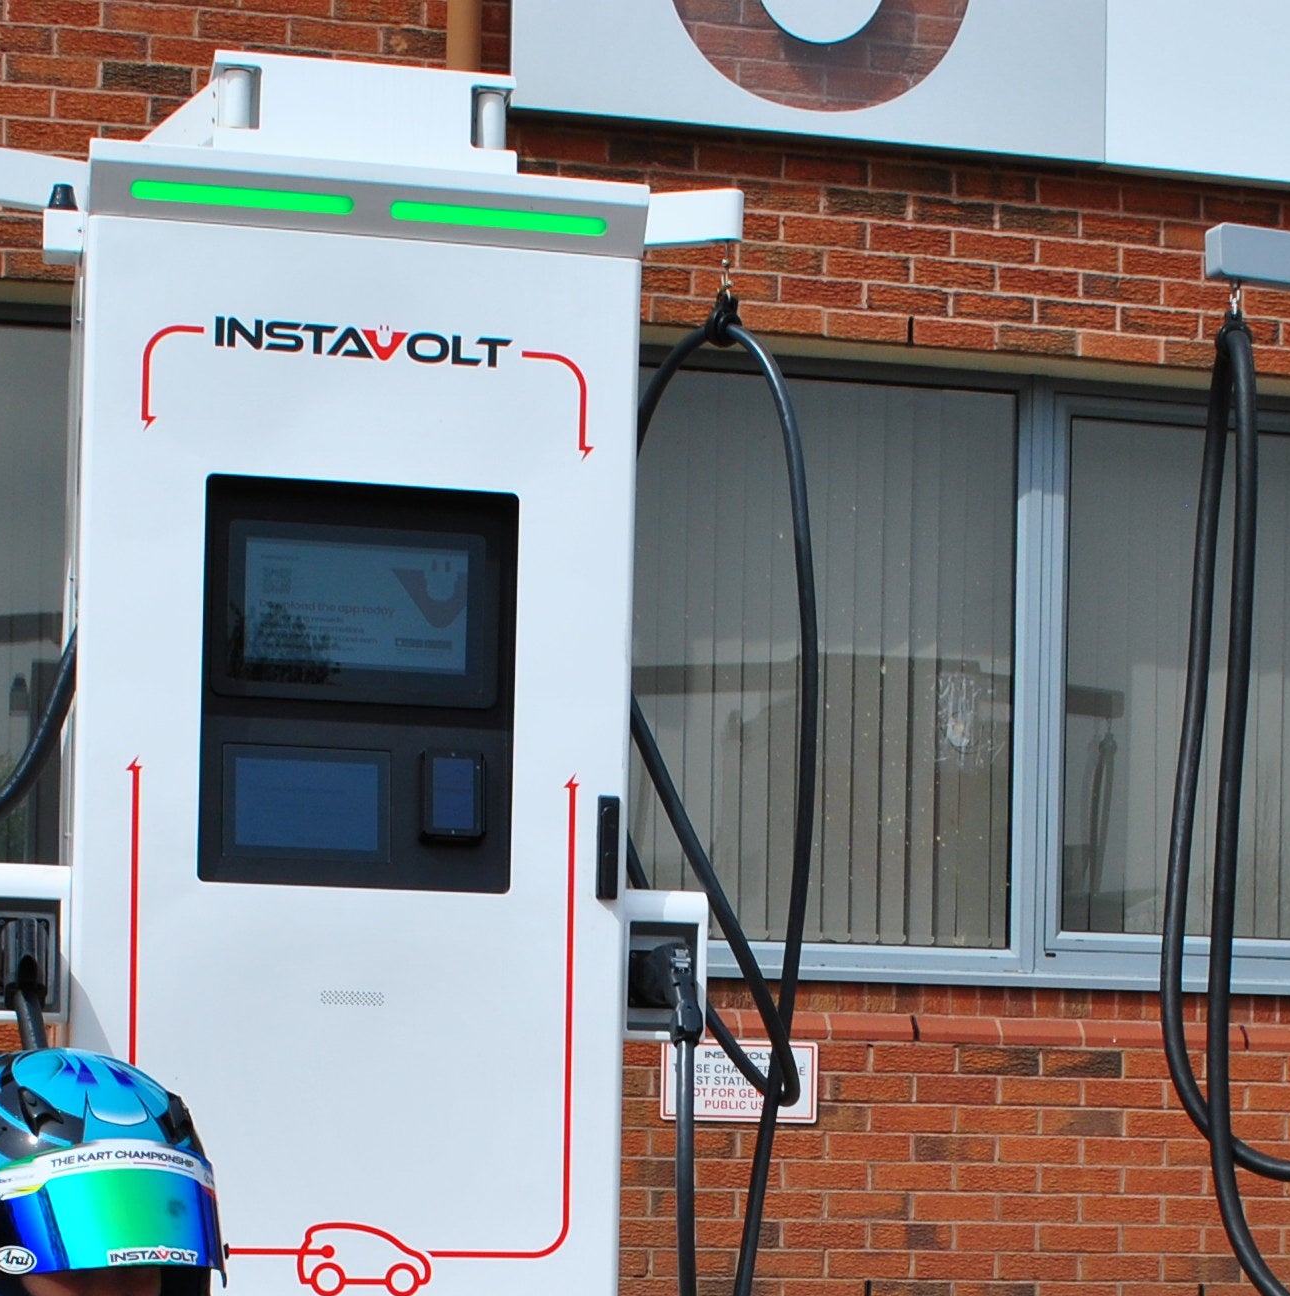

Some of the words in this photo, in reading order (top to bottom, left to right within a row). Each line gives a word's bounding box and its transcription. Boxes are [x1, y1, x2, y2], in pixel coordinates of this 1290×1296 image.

[214, 316, 513, 368] INSTAVOLT
[337, 605, 359, 615] app
[362, 605, 394, 617] today
[711, 1088, 736, 1098] FOR
[704, 1100, 747, 1111] PUBLIC
[750, 1101, 764, 1111] US
[51, 1156, 76, 1169] THE
[77, 1150, 113, 1164] KART
[114, 1150, 194, 1168] CHAMPIONSHIP
[110, 1249, 196, 1265] INSTAVOLT
